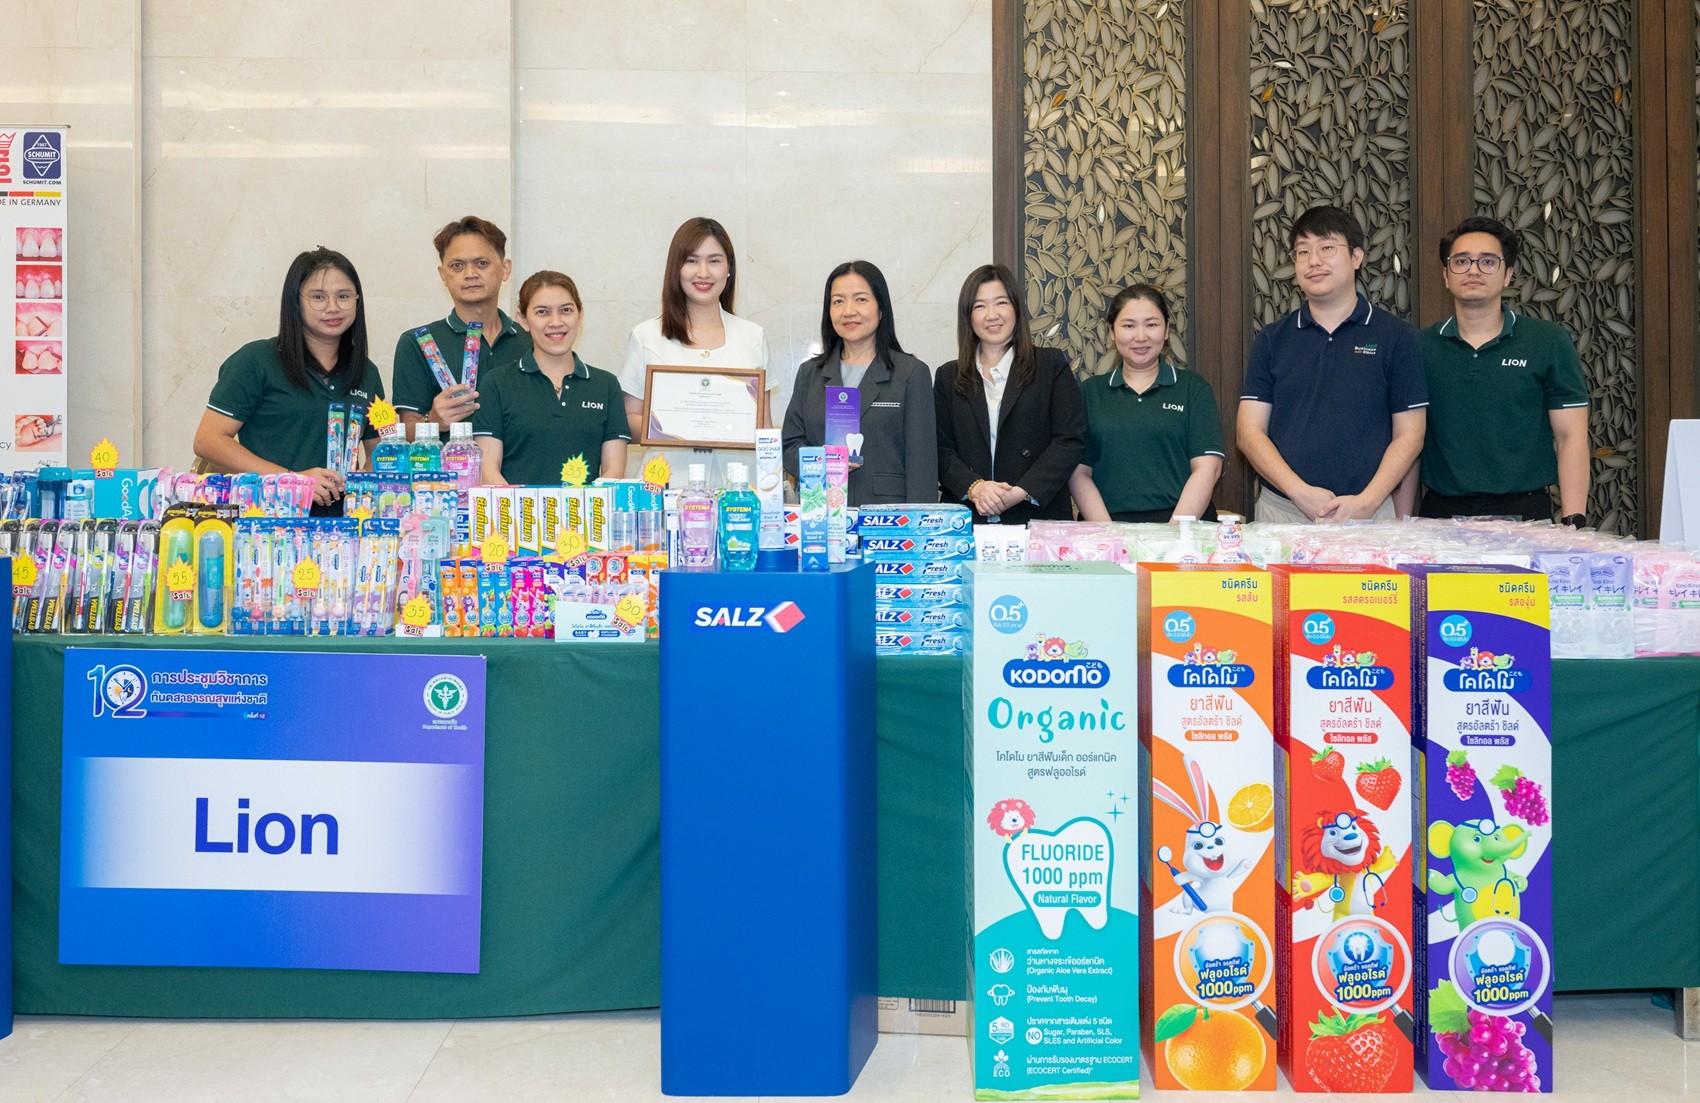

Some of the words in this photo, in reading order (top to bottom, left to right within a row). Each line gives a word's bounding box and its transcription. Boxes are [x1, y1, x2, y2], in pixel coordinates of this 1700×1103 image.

[1501, 359, 1527, 367] LION
[350, 389, 368, 399] LION
[582, 401, 603, 410] LION
[1162, 403, 1184, 412] LION
[375, 410, 389, 422] 50
[380, 425, 396, 435] Sale
[95, 452, 110, 463] 40
[566, 465, 582, 478] 35
[649, 465, 665, 478] 40
[646, 484, 660, 493] Sale
[863, 516, 895, 526] SALZ
[919, 515, 943, 526] Fresh
[489, 543, 504, 557] 20
[561, 535, 579, 554] 30
[868, 540, 900, 550] SALZ
[924, 539, 949, 550] Fresh
[570, 557, 586, 567] Sale
[876, 564, 898, 574] ALZ
[923, 563, 948, 574] Fresh
[13, 566, 28, 580] 45
[173, 571, 187, 585] 55
[299, 568, 314, 580] 25
[1222, 578, 1258, 589] ชนิดครีม
[1361, 580, 1398, 591] ชนิดครีม
[1499, 583, 1536, 593] ชนิดครีม
[1561, 585, 1582, 593] キレイ
[921, 588, 946, 599] Fresh
[1237, 592, 1258, 602] รสส้ม
[620, 600, 641, 616] 30
[1509, 596, 1536, 610] รสองุ่น
[28, 600, 38, 630] SYSTEMA
[44, 599, 55, 630] SYSTEMA
[89, 599, 98, 629] SYSTEMA
[114, 600, 124, 631] SYSTEMA
[130, 599, 141, 630] SYSTEMA
[406, 605, 425, 617] 35
[694, 607, 765, 626] SALZ
[876, 612, 897, 622] ALZ
[921, 611, 946, 622] Fresh
[406, 626, 422, 635] Sale
[614, 618, 629, 632] Sale
[921, 635, 946, 646] Fresh
[152, 669, 268, 689] การประชุมวิชาการ
[1183, 666, 1237, 685] โคโดโม
[1323, 669, 1377, 687] โคโดโม
[1460, 671, 1515, 690] โคโดโม
[150, 691, 268, 707] ทันตสาธารณสุขแห่งชาติ
[1191, 695, 1233, 711] ยาสีฟัน
[1329, 697, 1372, 713] ยาสีฟัน
[1466, 699, 1509, 715] ยาสีฟัน
[988, 697, 1126, 743] Organic
[1181, 715, 1223, 729] สูตรอัลตร้า
[1226, 714, 1242, 726] ชิลด์
[1320, 717, 1362, 732] สูตรอัลตร้า
[1365, 716, 1382, 729] ชิลด์
[1457, 721, 1500, 734] สูตรอัลตร้า
[1502, 719, 1519, 731] ชิลด์
[996, 751, 1024, 762] โคโดโม
[1027, 750, 1073, 762] ยาสีฟันเด็ก
[1076, 751, 1117, 763] ออร์แกนิค
[1027, 766, 1086, 779] สูตรฟลูออไรด์
[195, 797, 339, 855] Lion
[1022, 844, 1104, 861] FLUORIDE
[1022, 867, 1063, 885] 1000
[1069, 871, 1103, 888] ppm
[1038, 894, 1068, 904] Natural
[1071, 894, 1097, 904] Flavor
[1027, 967, 1054, 975] (Organic
[1088, 967, 1112, 975] Extract)
[1201, 963, 1248, 982] ฟลูออไรด์
[1339, 967, 1386, 985] ฟลูออไรด์
[1476, 969, 1524, 988] ฟลูออไรด์
[992, 1022, 998, 1032] 5
[1028, 1032, 1040, 1040] NO
[1027, 1067, 1060, 1075] (ECOCERT
